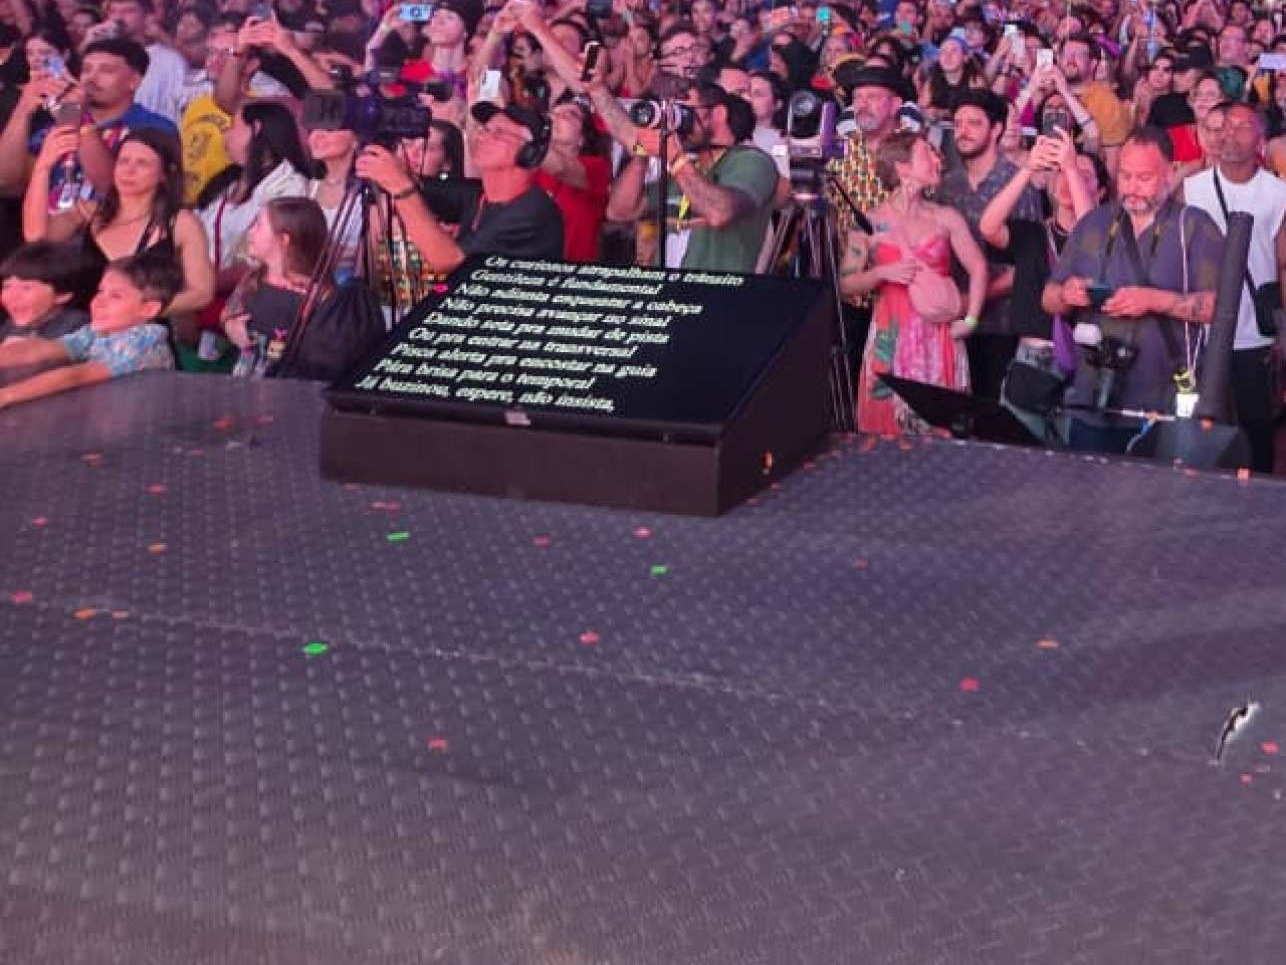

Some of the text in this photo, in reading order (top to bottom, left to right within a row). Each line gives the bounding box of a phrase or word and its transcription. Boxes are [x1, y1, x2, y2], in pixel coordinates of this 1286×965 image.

[471, 269, 663, 293] Gentileza é fundamental
[485, 255, 745, 285] Os curiosos atrapalham o trânsito
[438, 297, 673, 326] Não precisa avançar no sinal
[454, 283, 490, 296] Não
[490, 287, 550, 300] adianta
[552, 295, 631, 307] esquentar
[647, 300, 703, 314] cabeça
[408, 327, 639, 356] Ou pra entrar na transversal
[422, 311, 670, 344] Dando seta pra mudar de pista
[389, 342, 658, 377] Pisca alerta pra encostar na guia
[355, 375, 380, 389] Já
[455, 387, 515, 402] espere,
[517, 390, 554, 403] não
[415, 362, 460, 376] brisa
[456, 369, 499, 381] para
[500, 373, 515, 381] o
[515, 373, 596, 388] temporal
